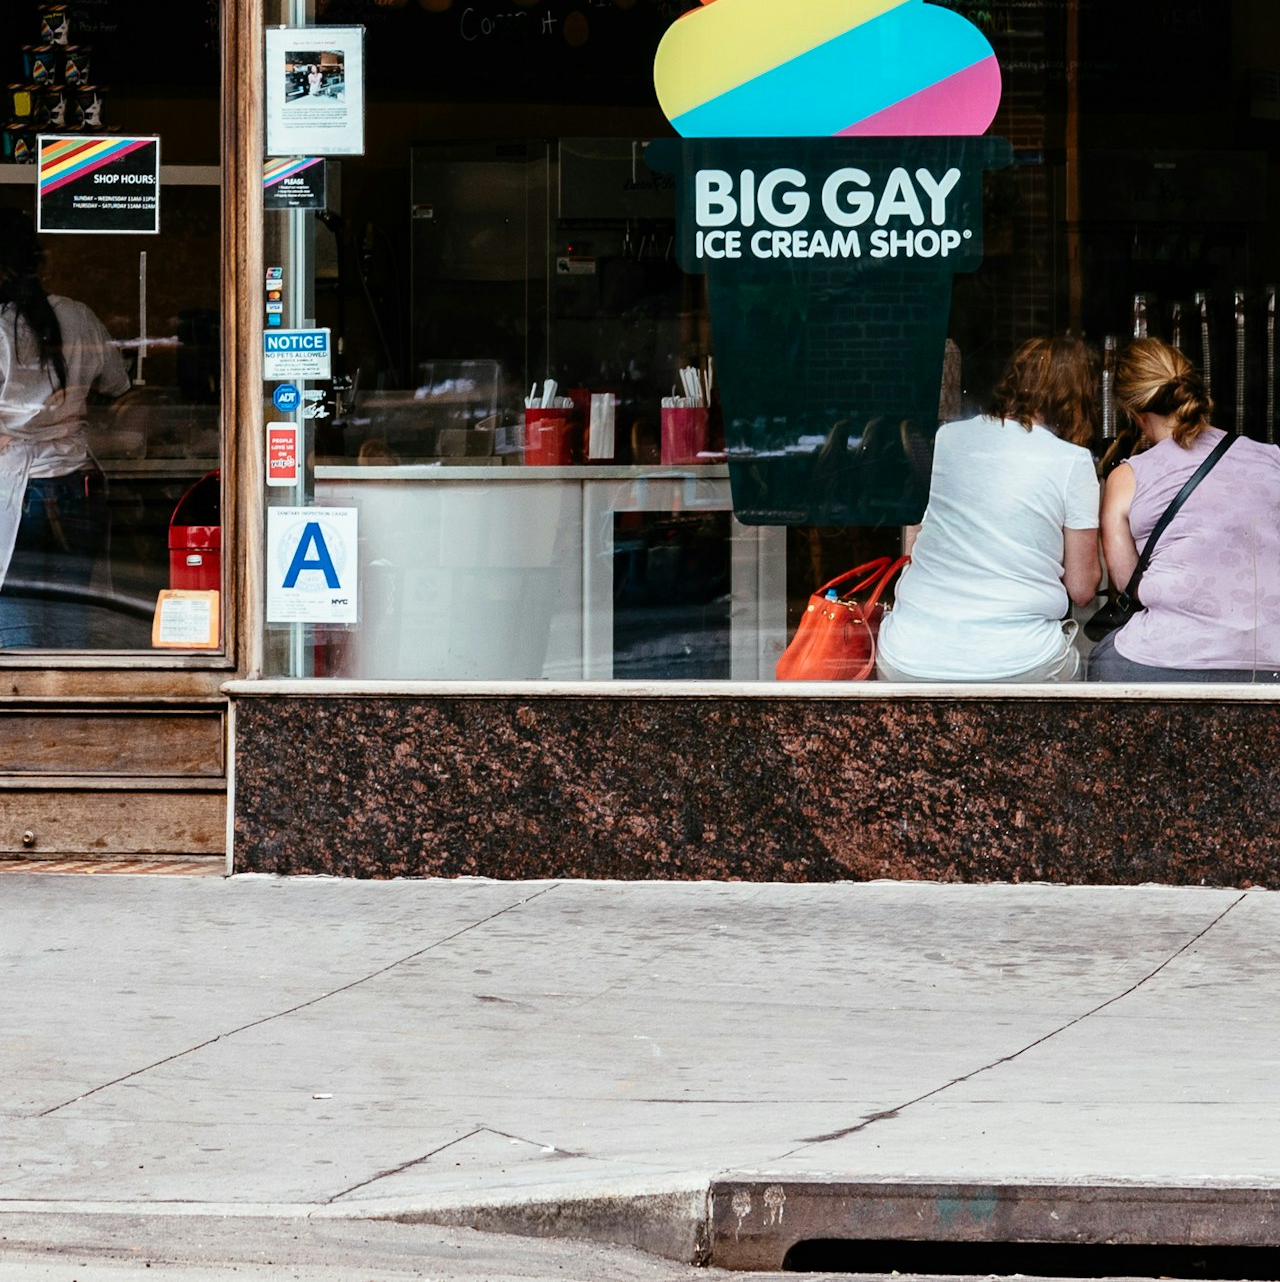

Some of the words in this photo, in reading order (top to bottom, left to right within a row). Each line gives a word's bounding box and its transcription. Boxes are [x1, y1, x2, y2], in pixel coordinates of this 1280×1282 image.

[94, 174, 119, 184] SHOP
[121, 174, 156, 184] HOURS:
[695, 167, 811, 228] BIG
[821, 166, 962, 228] GAY
[695, 230, 742, 259] ICE
[750, 229, 862, 259] CREAM
[268, 335, 324, 349] NOTICE
[279, 392, 296, 403] ADT
[282, 522, 341, 589] A
